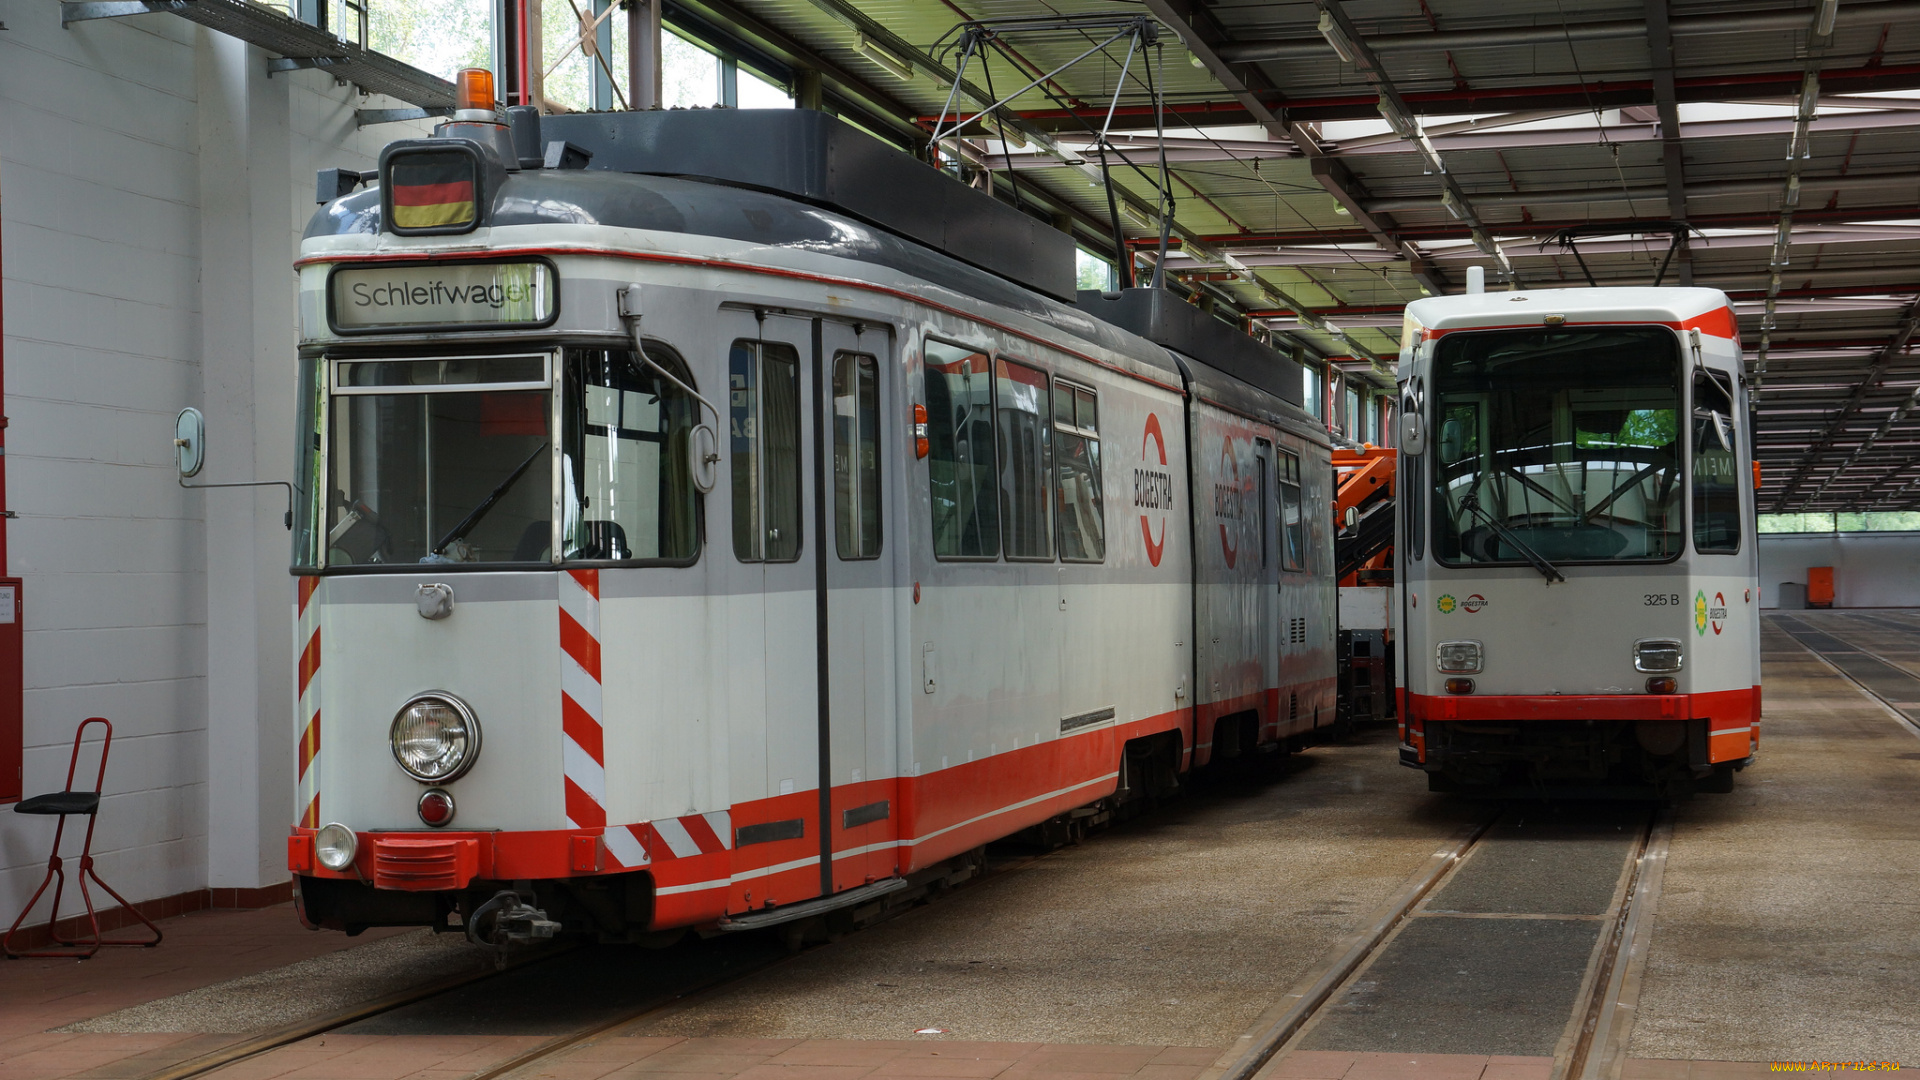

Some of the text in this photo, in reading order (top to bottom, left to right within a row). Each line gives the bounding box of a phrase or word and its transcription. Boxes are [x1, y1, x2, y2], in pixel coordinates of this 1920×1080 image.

[1134, 468, 1173, 510] BOGESTRA
[1215, 483, 1244, 520] BOGESTRA
[1644, 594, 1680, 606] 325 B
